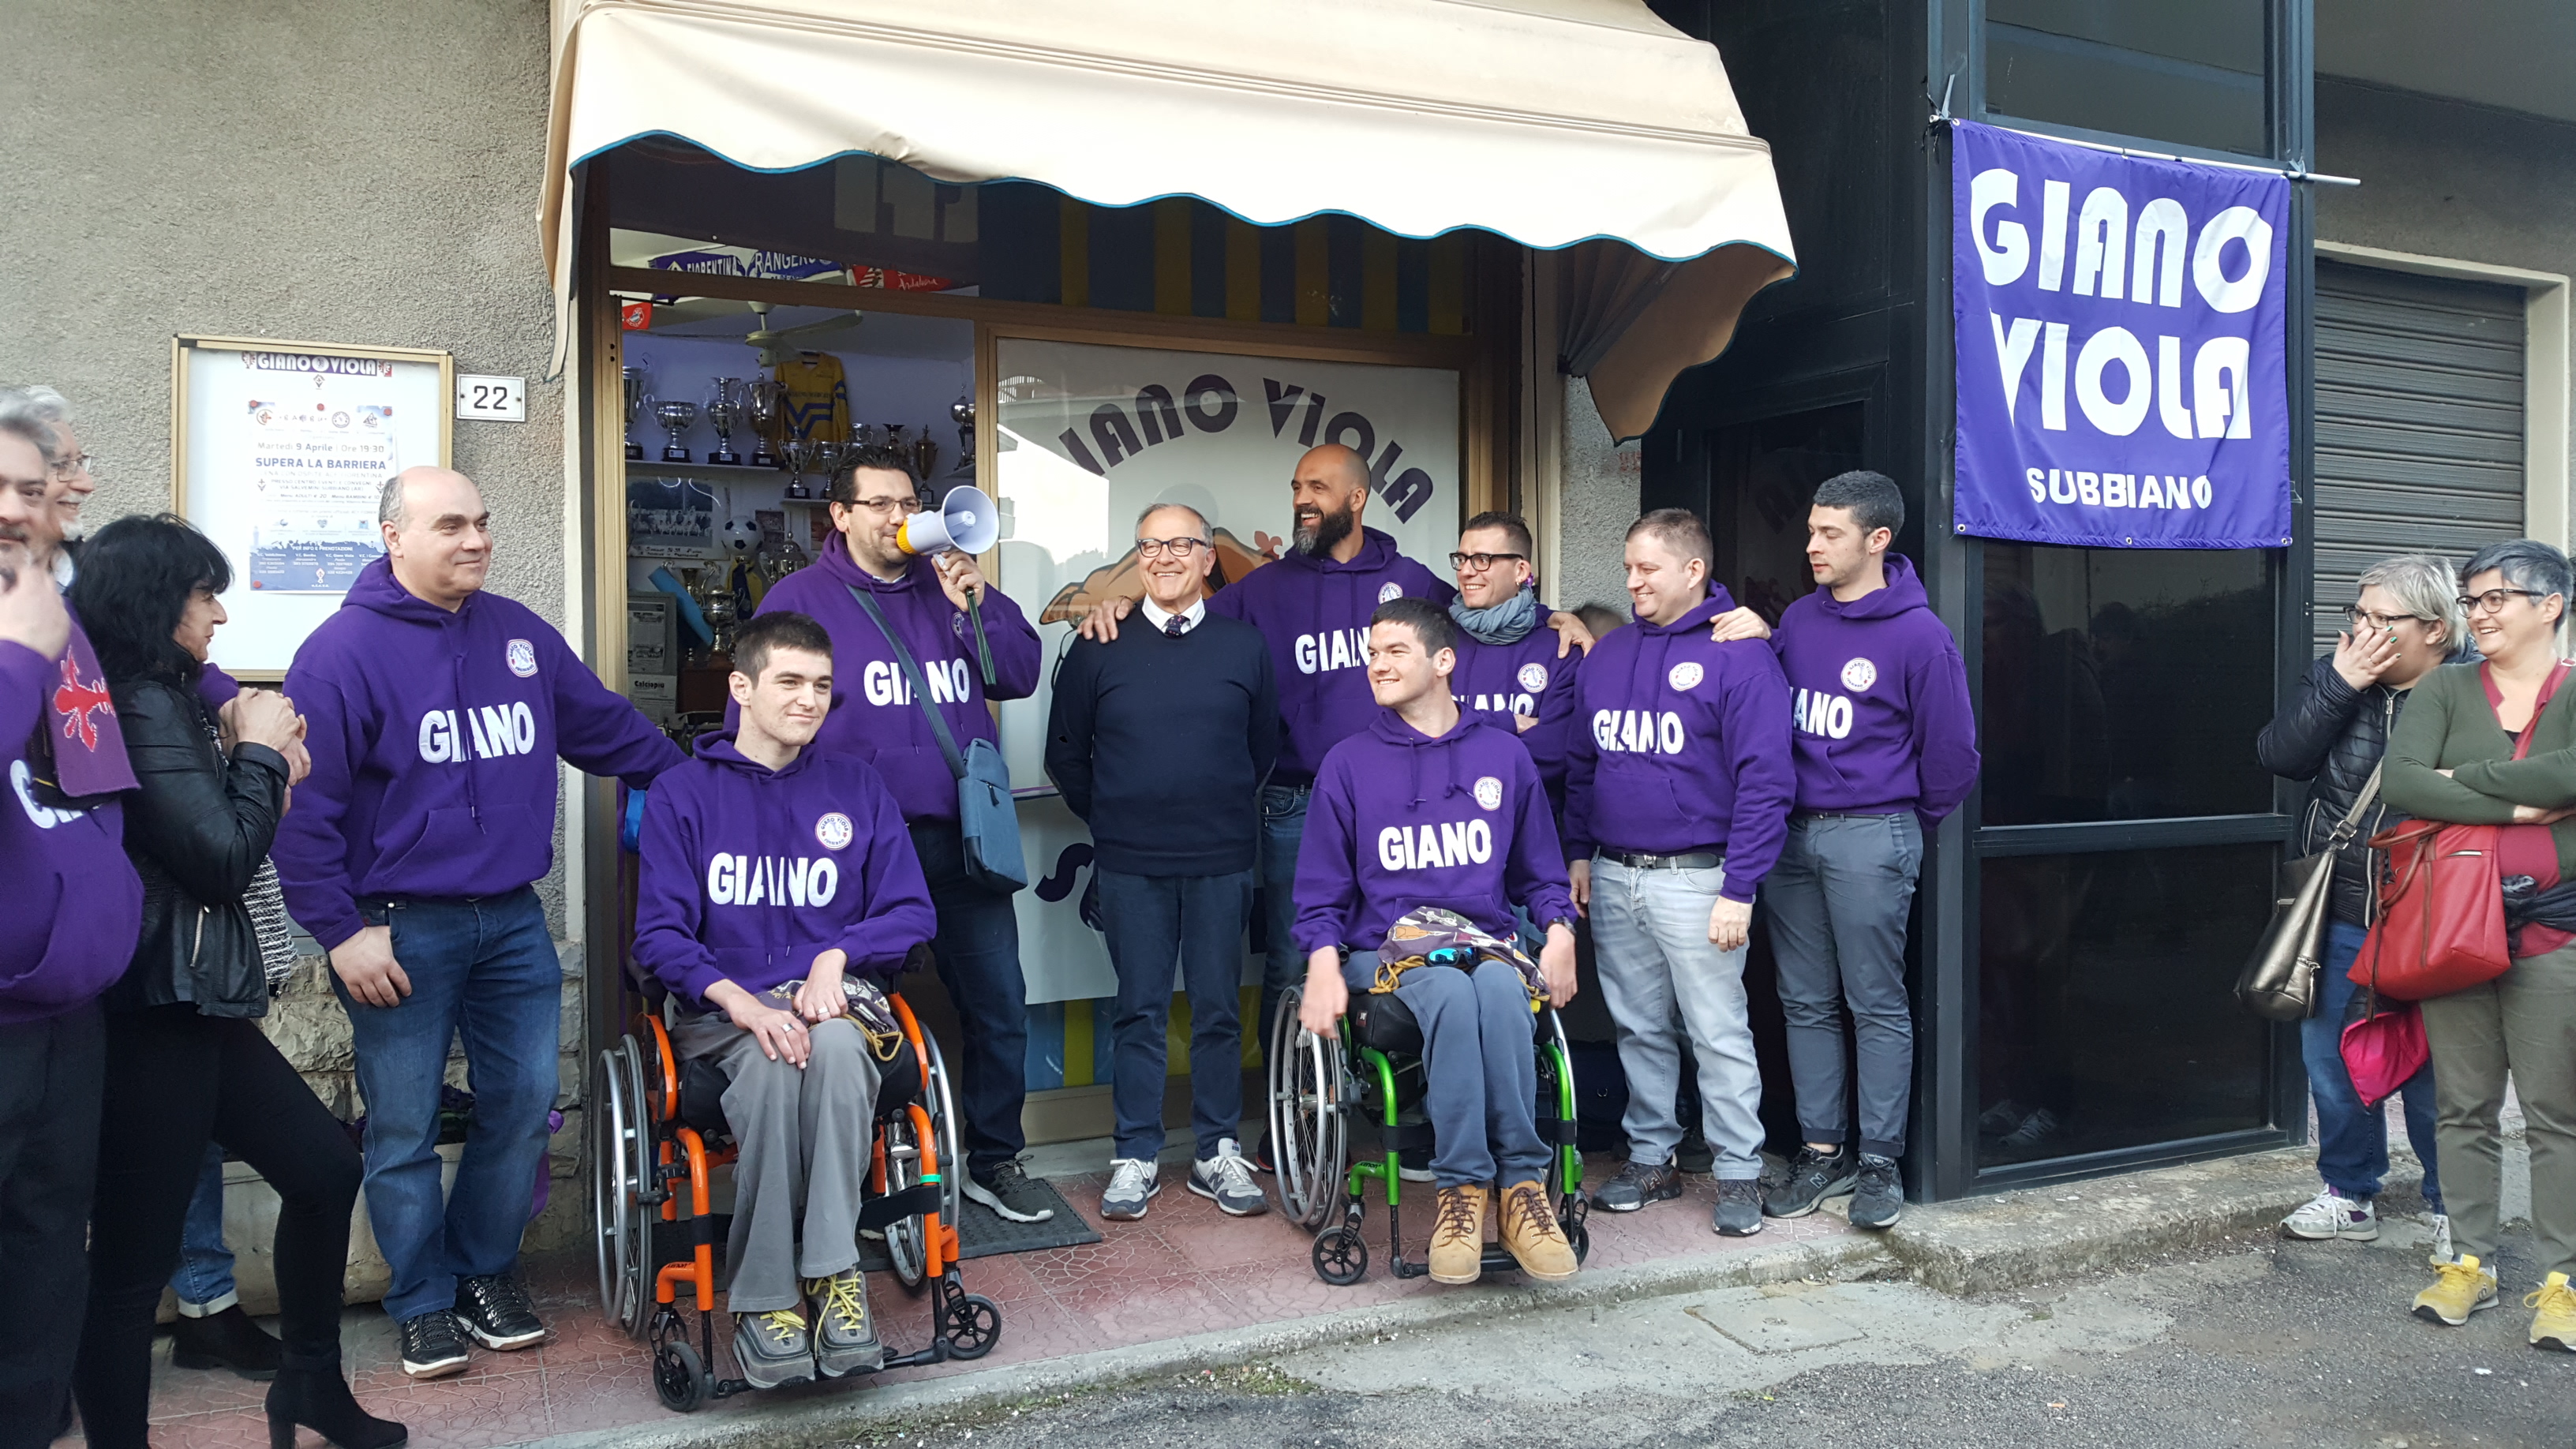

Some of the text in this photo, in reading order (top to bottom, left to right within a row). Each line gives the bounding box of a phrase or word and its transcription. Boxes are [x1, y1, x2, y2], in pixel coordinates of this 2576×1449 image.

[1971, 168, 2273, 313] GIANO
[687, 256, 737, 276] FIORENTINA
[257, 354, 376, 375] GIANO VIOLA
[1990, 307, 2252, 440] VIOLA
[474, 385, 507, 410] 22
[256, 457, 387, 470] SUPERA LA BARRIERA
[305, 443, 333, 454] Aprile
[1263, 377, 1433, 524] VIOLA
[2026, 467, 2212, 510] SUBBIANO
[418, 701, 535, 763] GIANO
[1593, 709, 1684, 754] GIANO
[1378, 818, 1492, 871] GIANO
[709, 852, 838, 908] GIANO
